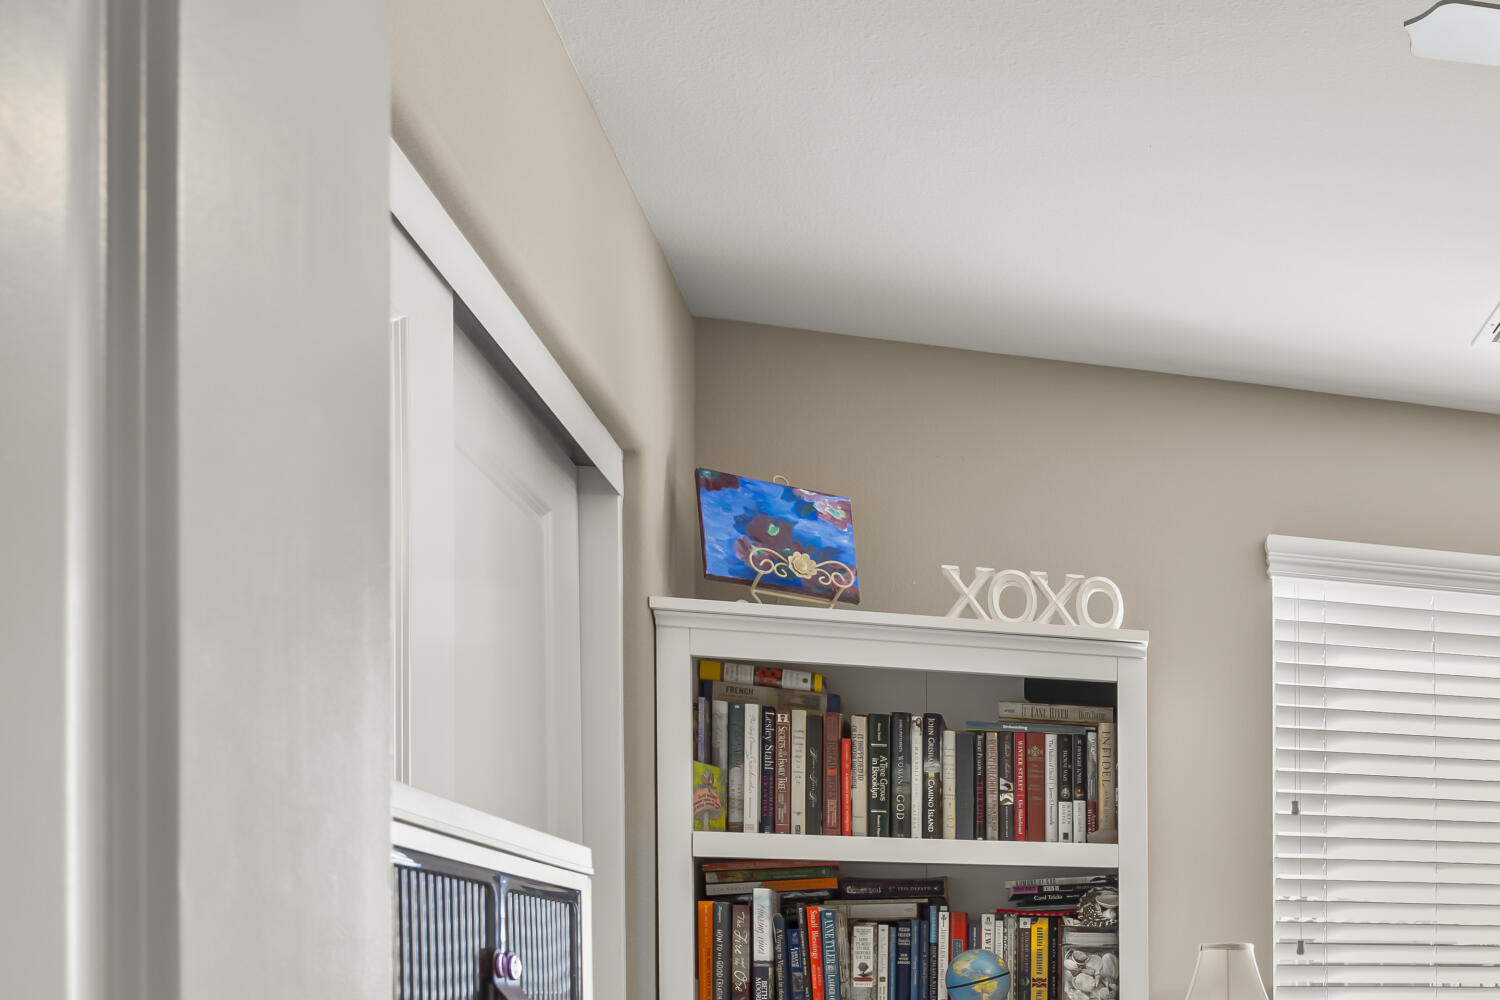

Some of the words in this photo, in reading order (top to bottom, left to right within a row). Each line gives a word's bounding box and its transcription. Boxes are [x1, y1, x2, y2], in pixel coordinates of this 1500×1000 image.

[940, 564, 1125, 630] XOXO
[726, 686, 753, 695] FRENCH
[763, 712, 774, 742] Lesley
[778, 726, 787, 749] SECRETS
[764, 744, 774, 770] Stahl
[778, 759, 787, 776] FAMILY
[1101, 731, 1111, 786] INFIDEL
[880, 762, 888, 776] Tree
[778, 777, 788, 791] TREE
[871, 766, 879, 798] Brooklyn
[880, 778, 888, 801] Grows
[896, 794, 905, 819] GOD
[736, 912, 745, 928] The
[810, 910, 818, 928] Small
[824, 919, 834, 938] ANNE
[733, 929, 748, 955] Fire
[811, 931, 819, 959] Blessings
[825, 939, 835, 964] TYLER
[734, 970, 748, 992] Ore
